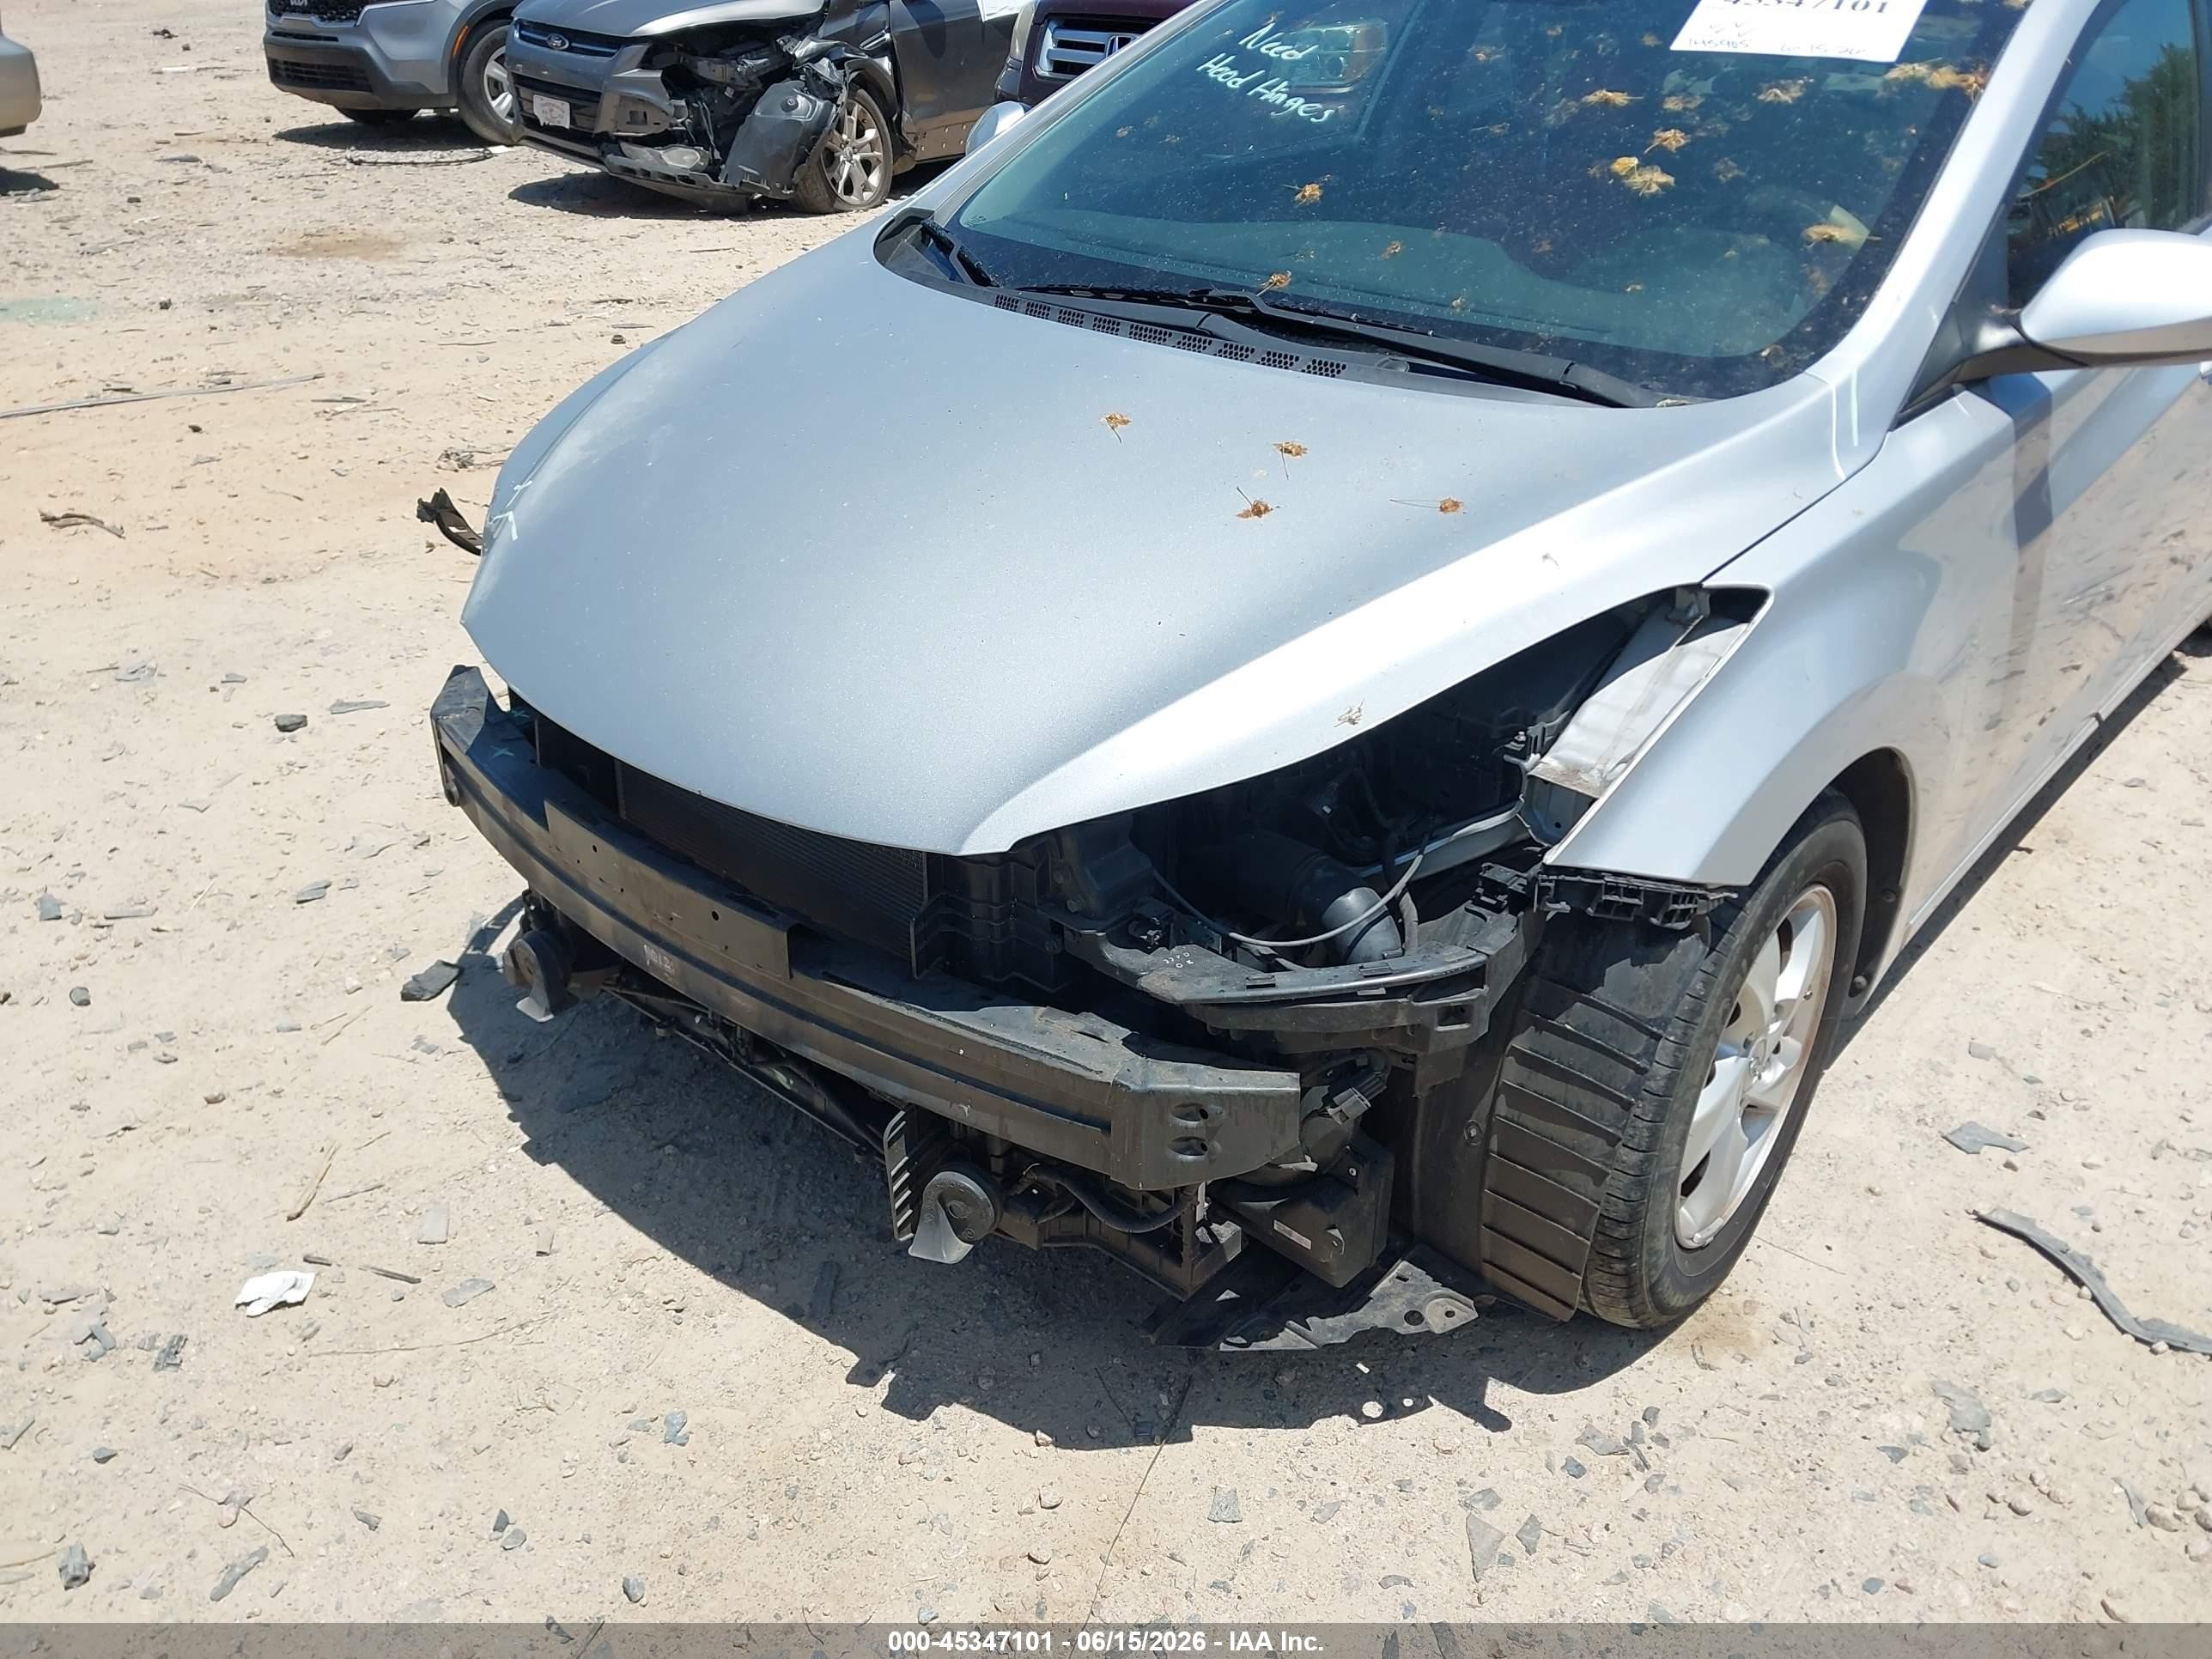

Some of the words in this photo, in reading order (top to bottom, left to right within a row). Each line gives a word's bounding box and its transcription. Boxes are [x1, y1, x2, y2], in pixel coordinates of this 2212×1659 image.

[1237, 22, 1318, 60] Need
[1196, 52, 1265, 89] Hood
[1247, 77, 1334, 123] Hinges
